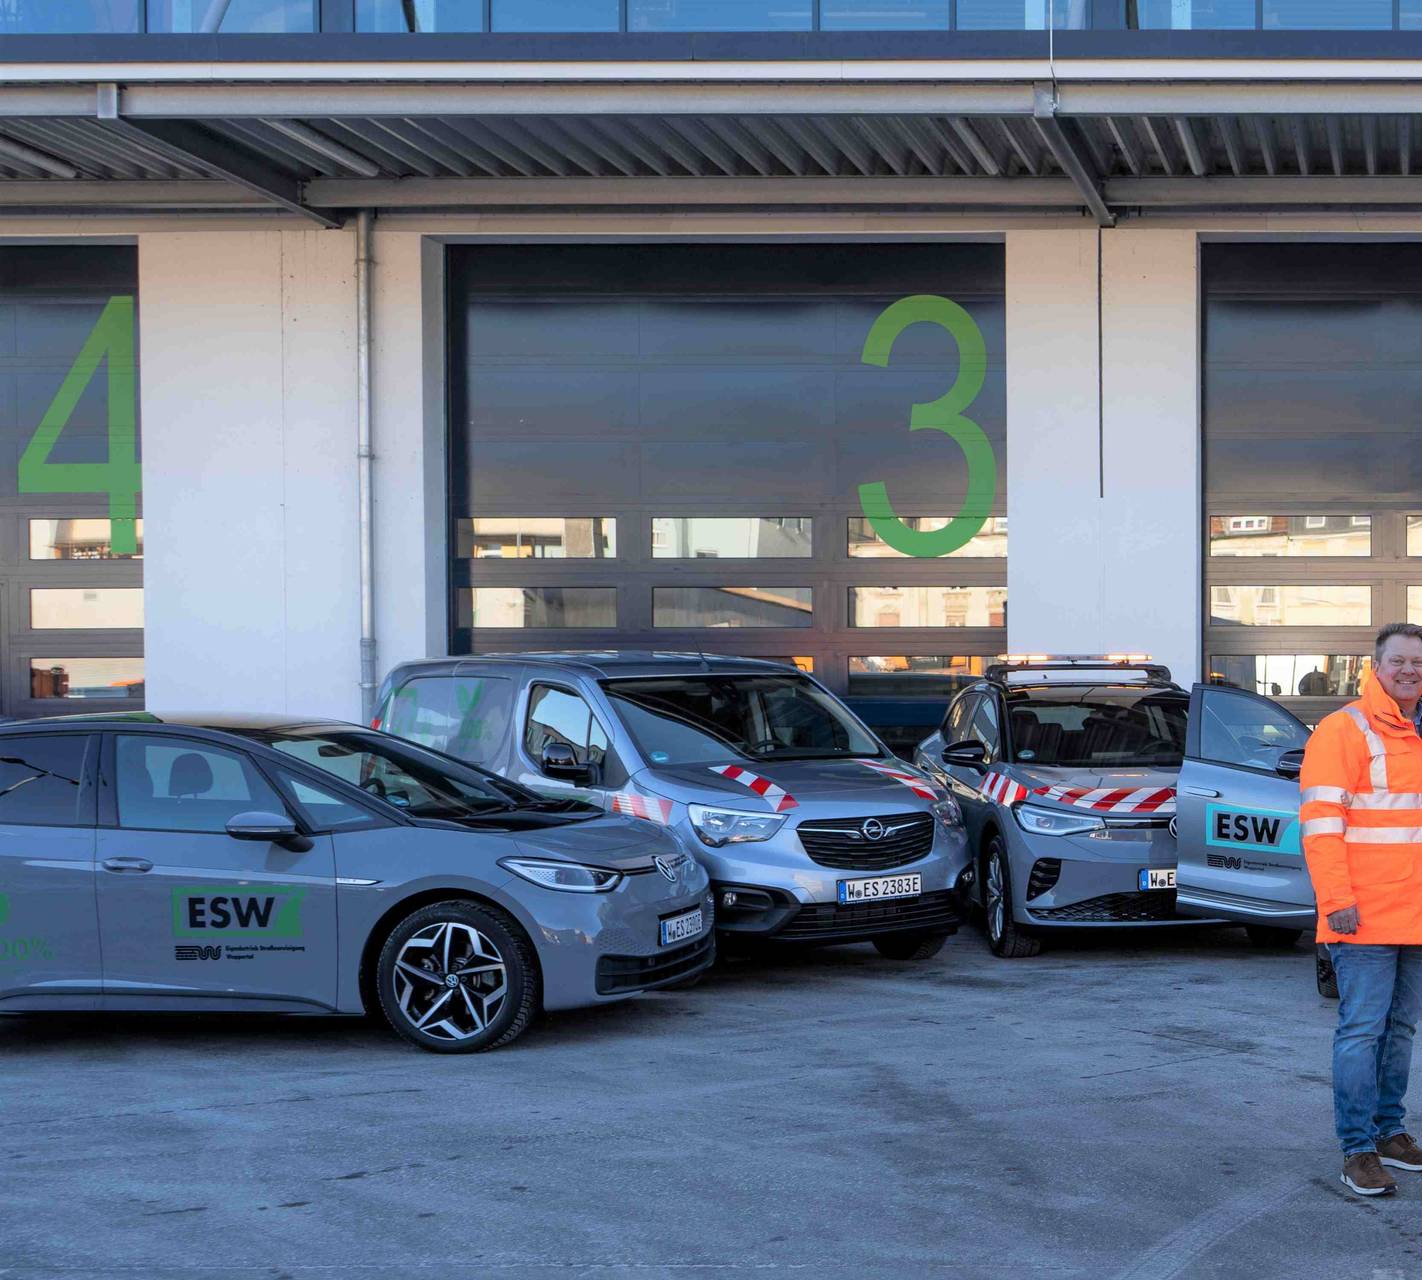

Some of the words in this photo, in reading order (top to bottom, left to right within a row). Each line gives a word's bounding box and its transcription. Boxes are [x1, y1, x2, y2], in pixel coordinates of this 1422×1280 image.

[18, 295, 142, 554] 4
[858, 294, 996, 557] 3
[1216, 813, 1281, 844] ESW
[847, 883, 856, 899] W
[863, 881, 880, 898] ES
[882, 876, 920, 895] 2383E
[187, 896, 276, 929] ESW
